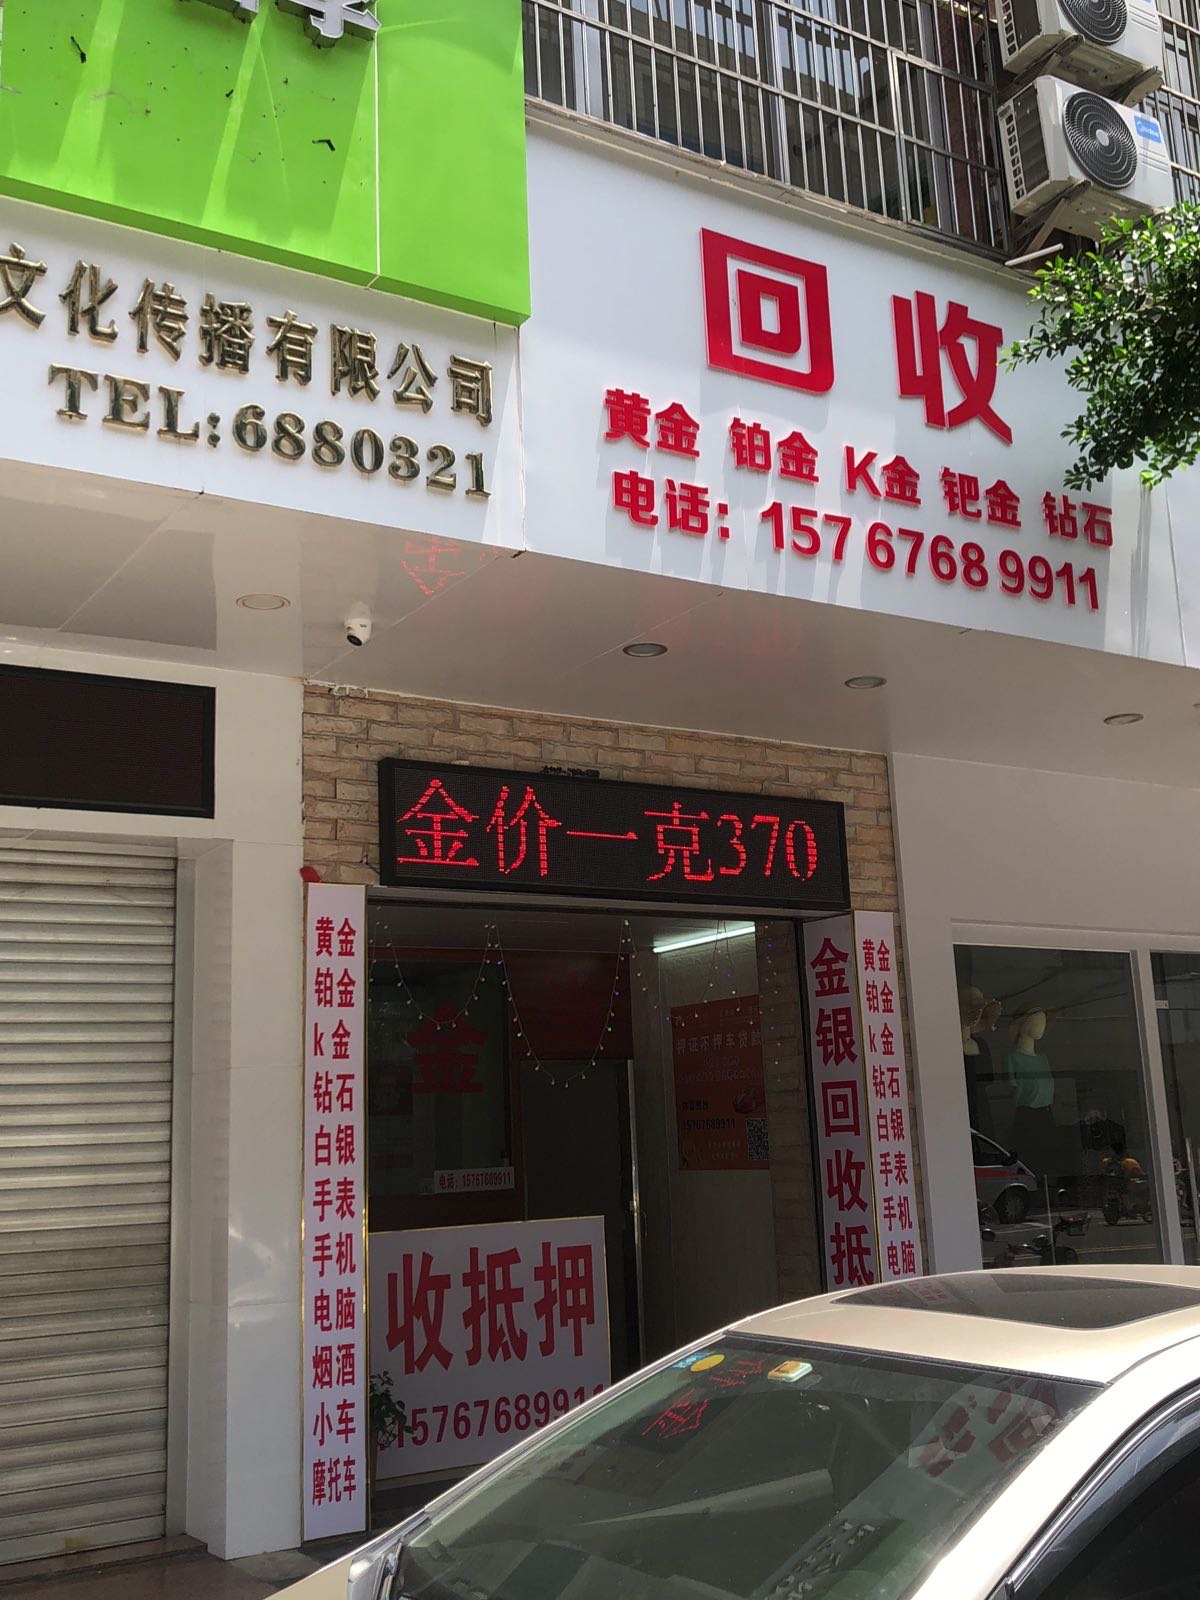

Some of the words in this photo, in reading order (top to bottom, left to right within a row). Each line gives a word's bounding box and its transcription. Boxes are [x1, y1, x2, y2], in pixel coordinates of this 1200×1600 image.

[0, 242, 494, 428] 文化传播有限公司
[700, 227, 1013, 444] 回收
[603, 388, 700, 458] 黄金
[729, 416, 819, 484] 铂金
[844, 445, 922, 506] K金
[939, 465, 1022, 529] 钯金
[1040, 490, 1113, 548] 钻石
[396, 778, 818, 883] 金价一克370
[315, 916, 357, 958] 黄金
[862, 938, 891, 973] 黄金
[314, 966, 356, 1009] 铂金
[865, 979, 894, 1014] 铂金
[313, 1018, 351, 1060] k金
[407, 1002, 488, 1094] 金
[867, 1022, 895, 1057] k金
[313, 1070, 355, 1114] 钻石
[872, 1064, 900, 1100] 钻石
[314, 1123, 356, 1167] 白银
[876, 1107, 905, 1142] 白银
[879, 1150, 909, 1187] 手表
[312, 1176, 356, 1222] 手表
[883, 1194, 913, 1231] 手机
[312, 1231, 356, 1278] 手机
[886, 1239, 917, 1276] 电脑
[313, 1286, 356, 1333] 电脑
[385, 1240, 597, 1376] 收抵押
[312, 1342, 356, 1390] 烟酒
[312, 1398, 356, 1447] 小车
[311, 1454, 357, 1506] 摩托车
